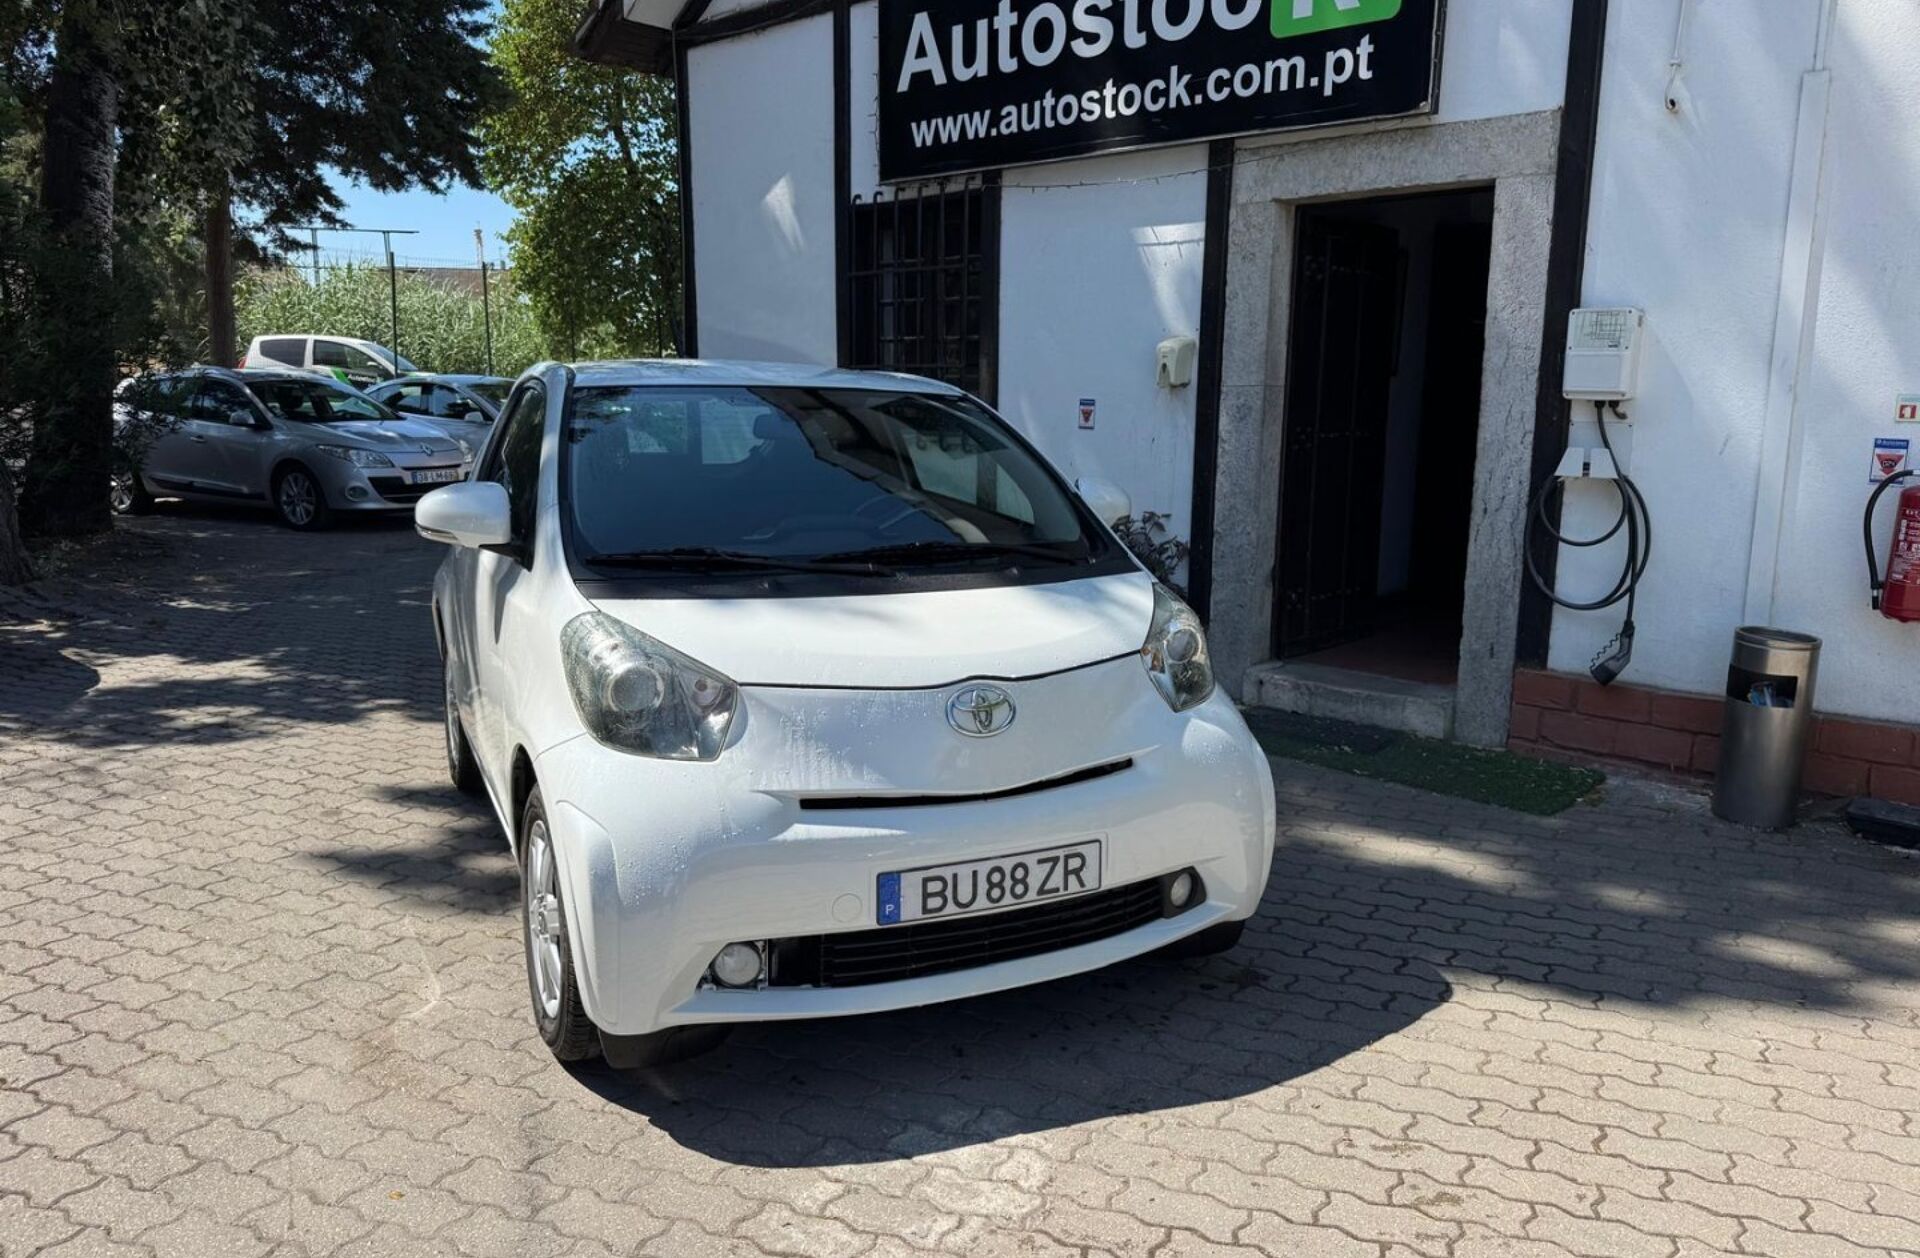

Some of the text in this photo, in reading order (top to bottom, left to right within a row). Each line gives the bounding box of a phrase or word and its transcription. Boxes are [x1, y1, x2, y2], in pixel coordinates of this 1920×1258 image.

[897, 0, 1361, 93] Autosto
[910, 33, 1374, 148] www.autostock.com.pt
[885, 904, 895, 915] P
